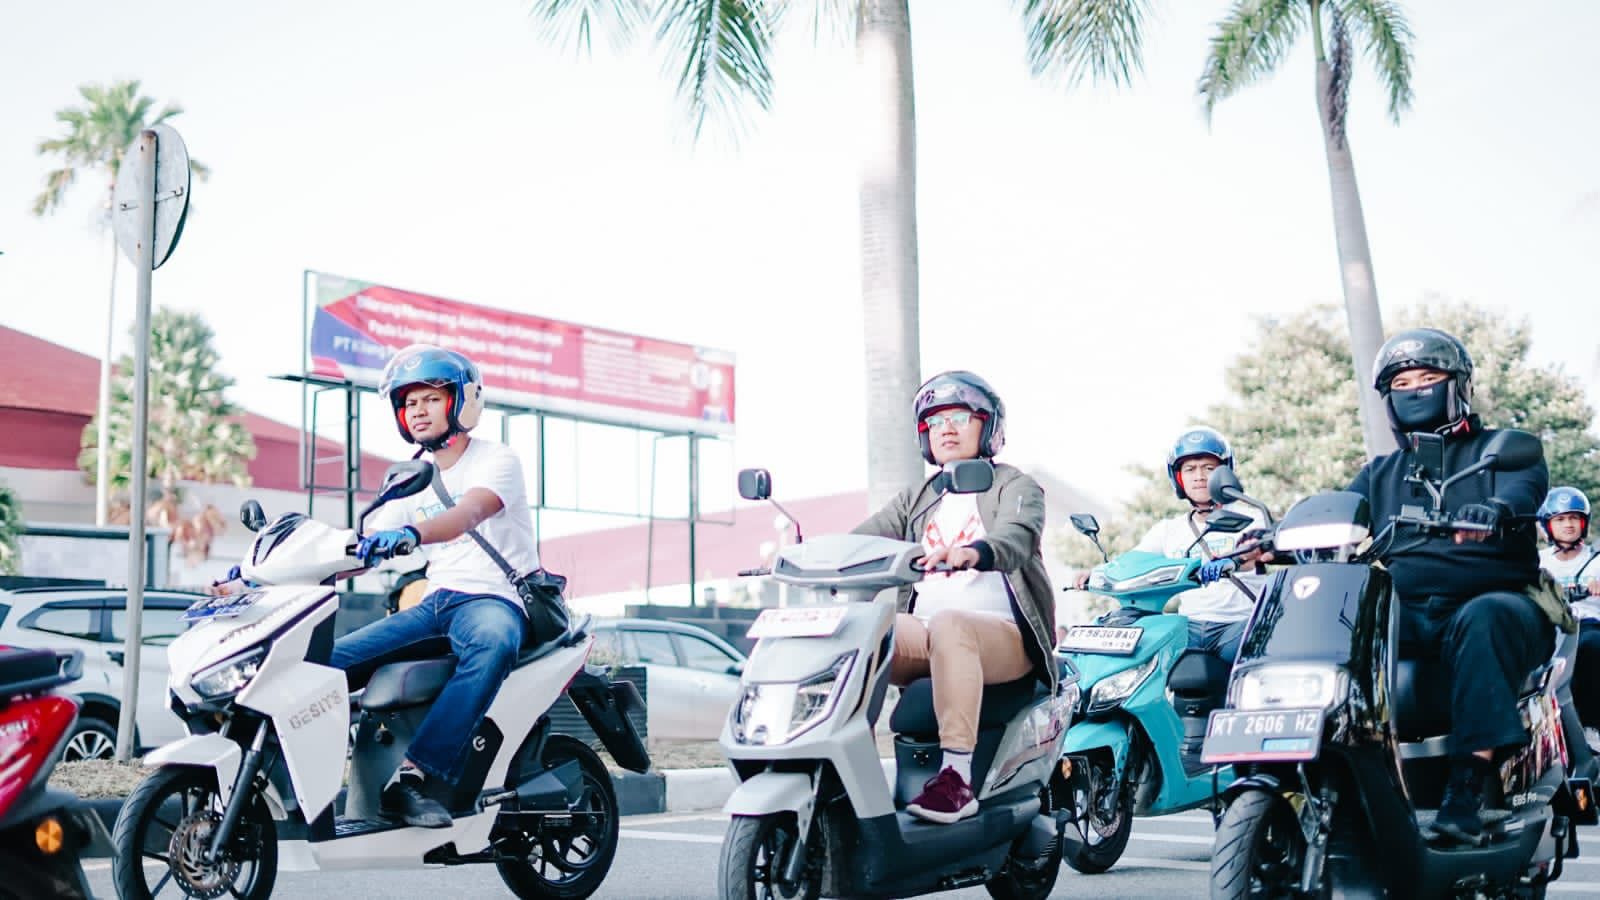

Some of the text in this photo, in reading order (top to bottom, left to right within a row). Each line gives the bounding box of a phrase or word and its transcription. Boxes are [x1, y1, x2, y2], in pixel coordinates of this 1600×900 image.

[1214, 713, 1318, 736] KT 2606 HZ
